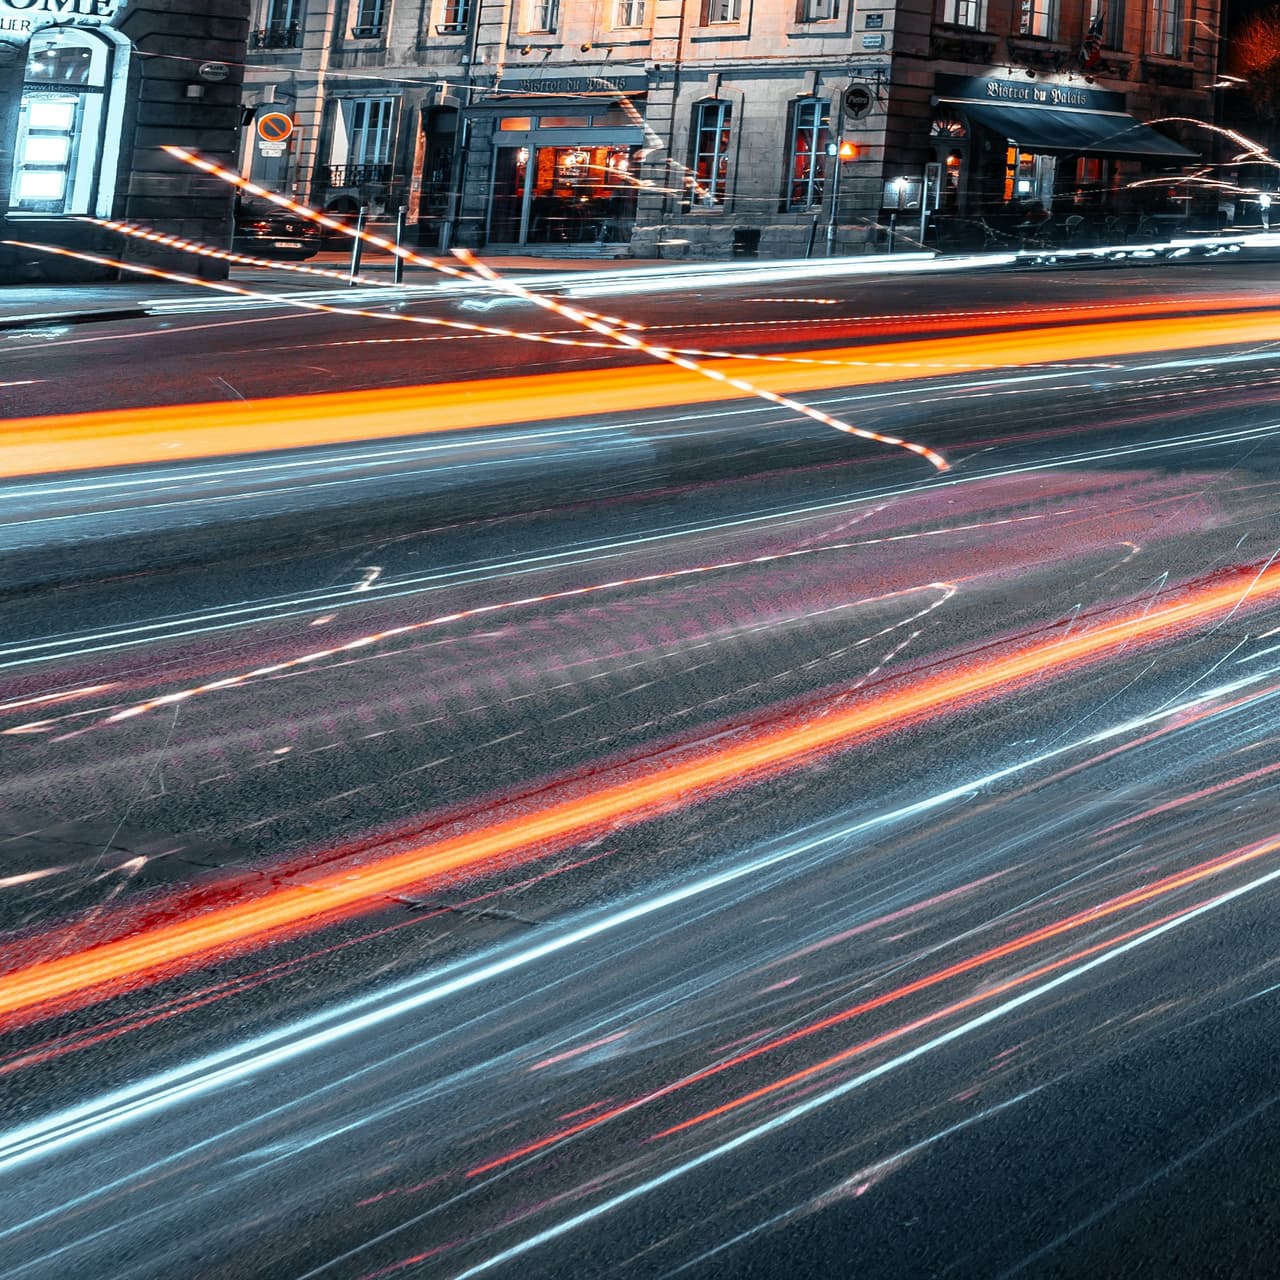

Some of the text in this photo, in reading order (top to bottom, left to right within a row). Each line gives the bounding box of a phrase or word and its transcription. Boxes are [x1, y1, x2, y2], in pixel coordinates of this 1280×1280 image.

[520, 79, 560, 92] Bistrot
[567, 79, 580, 91] du
[986, 81, 1087, 105] Bistrot du Palais
